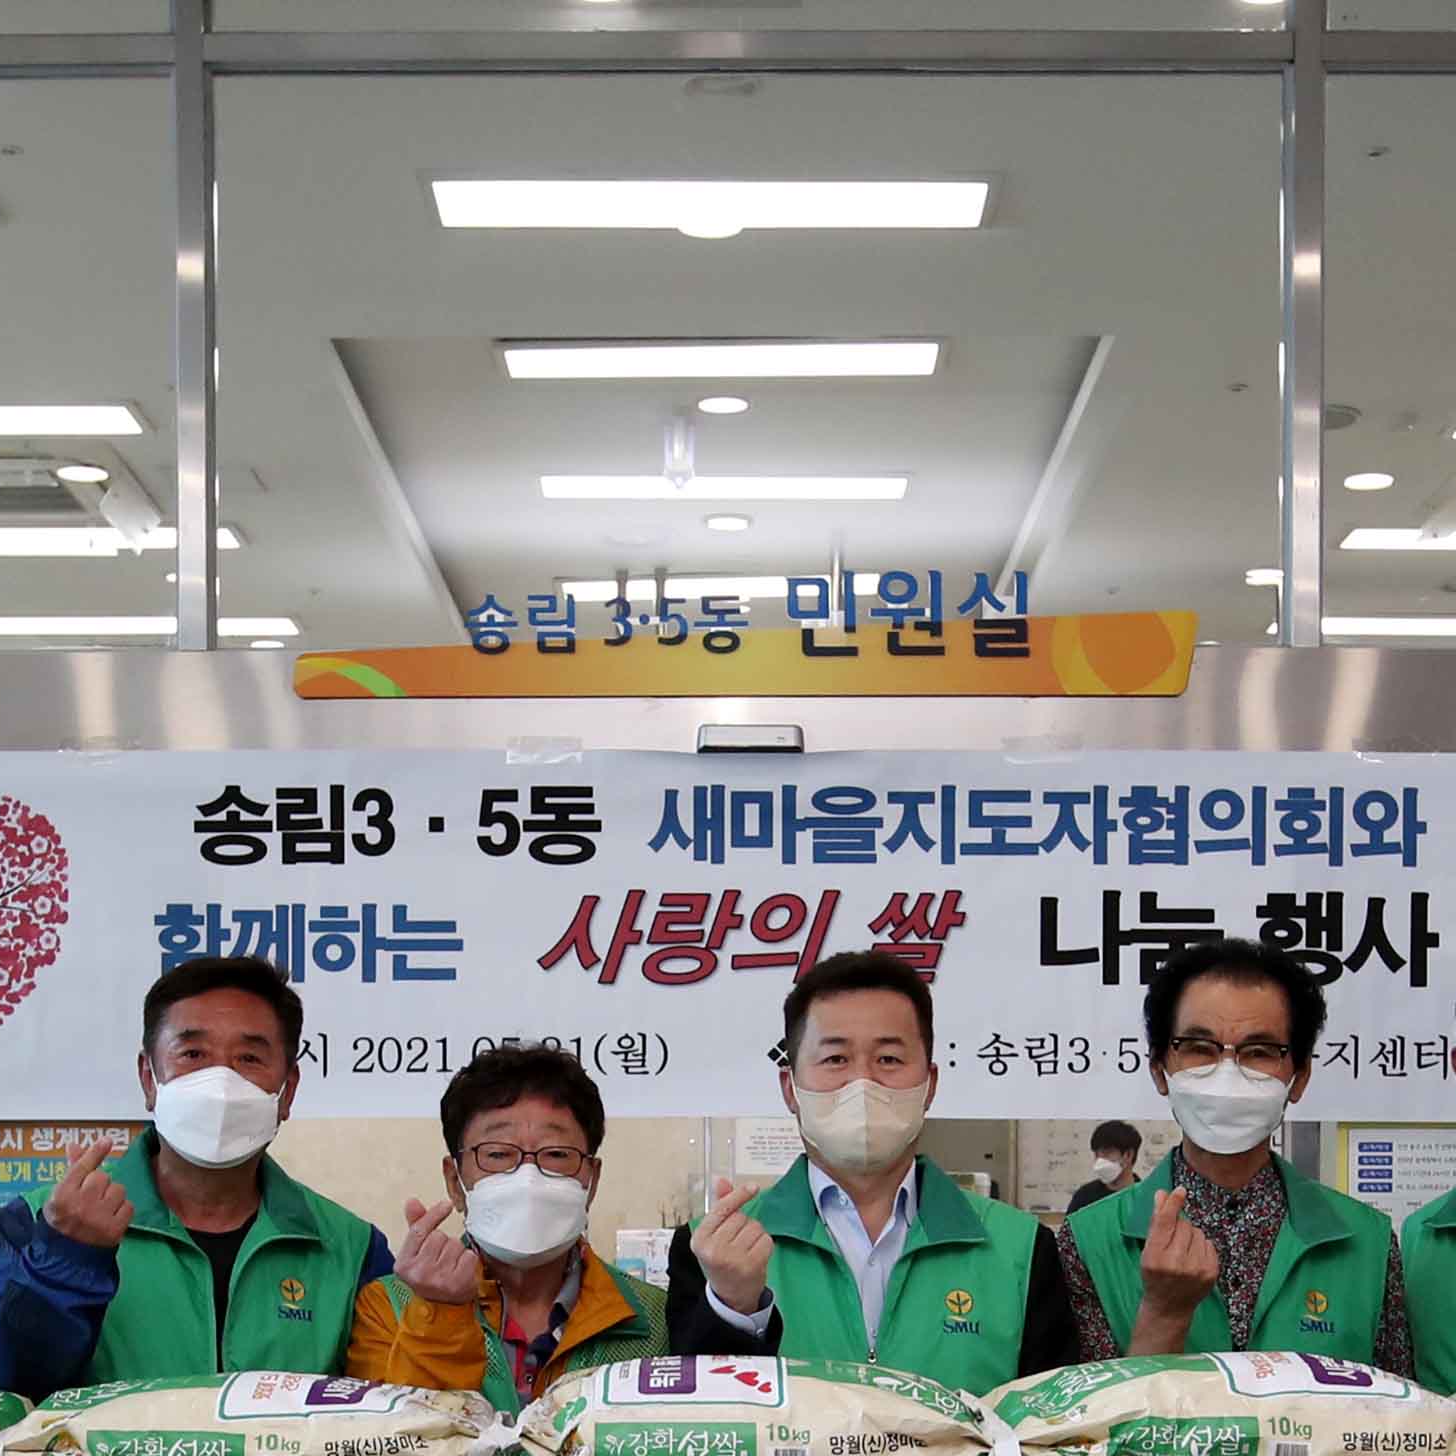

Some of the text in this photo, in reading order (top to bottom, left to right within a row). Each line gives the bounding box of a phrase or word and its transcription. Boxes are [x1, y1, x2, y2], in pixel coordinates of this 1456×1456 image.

[463, 593, 577, 655] 송림
[786, 569, 1031, 658] 민원실
[647, 782, 1427, 869] 새마을지도자협의회와
[153, 903, 464, 984] 함께하는
[536, 888, 842, 985] 사랑의
[867, 889, 967, 984] 쌀
[1255, 890, 1441, 988] 행사
[296, 1031, 328, 1078] 시
[975, 1033, 1151, 1078] 송림3·5
[1311, 1033, 1451, 1080] 지센터
[1266, 1415, 1313, 1440] 10kg
